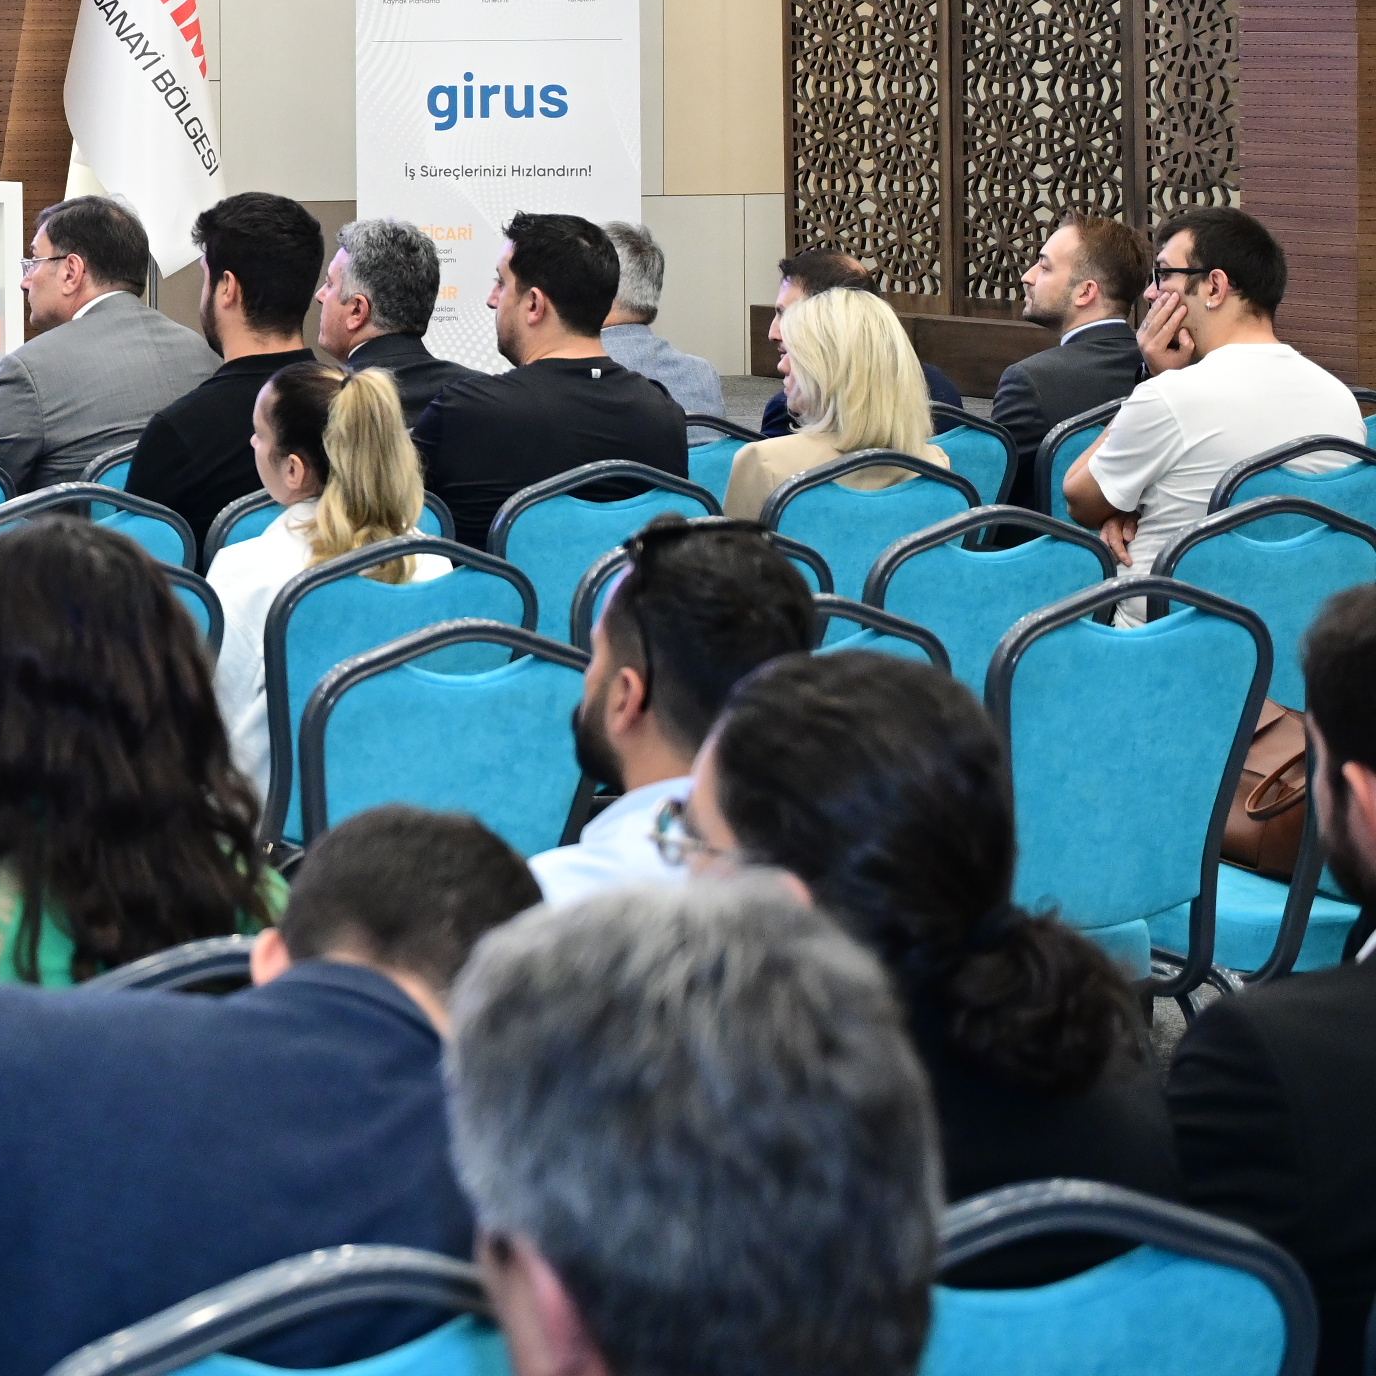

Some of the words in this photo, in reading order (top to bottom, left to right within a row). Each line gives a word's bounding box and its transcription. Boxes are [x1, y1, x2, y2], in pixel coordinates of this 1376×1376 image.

[151, 68, 222, 177] BÖLGESİ
[427, 72, 568, 131] girus
[405, 163, 415, 180] İş
[421, 165, 506, 180] Süreçlerinizi
[512, 165, 591, 176] Hızlandırın!
